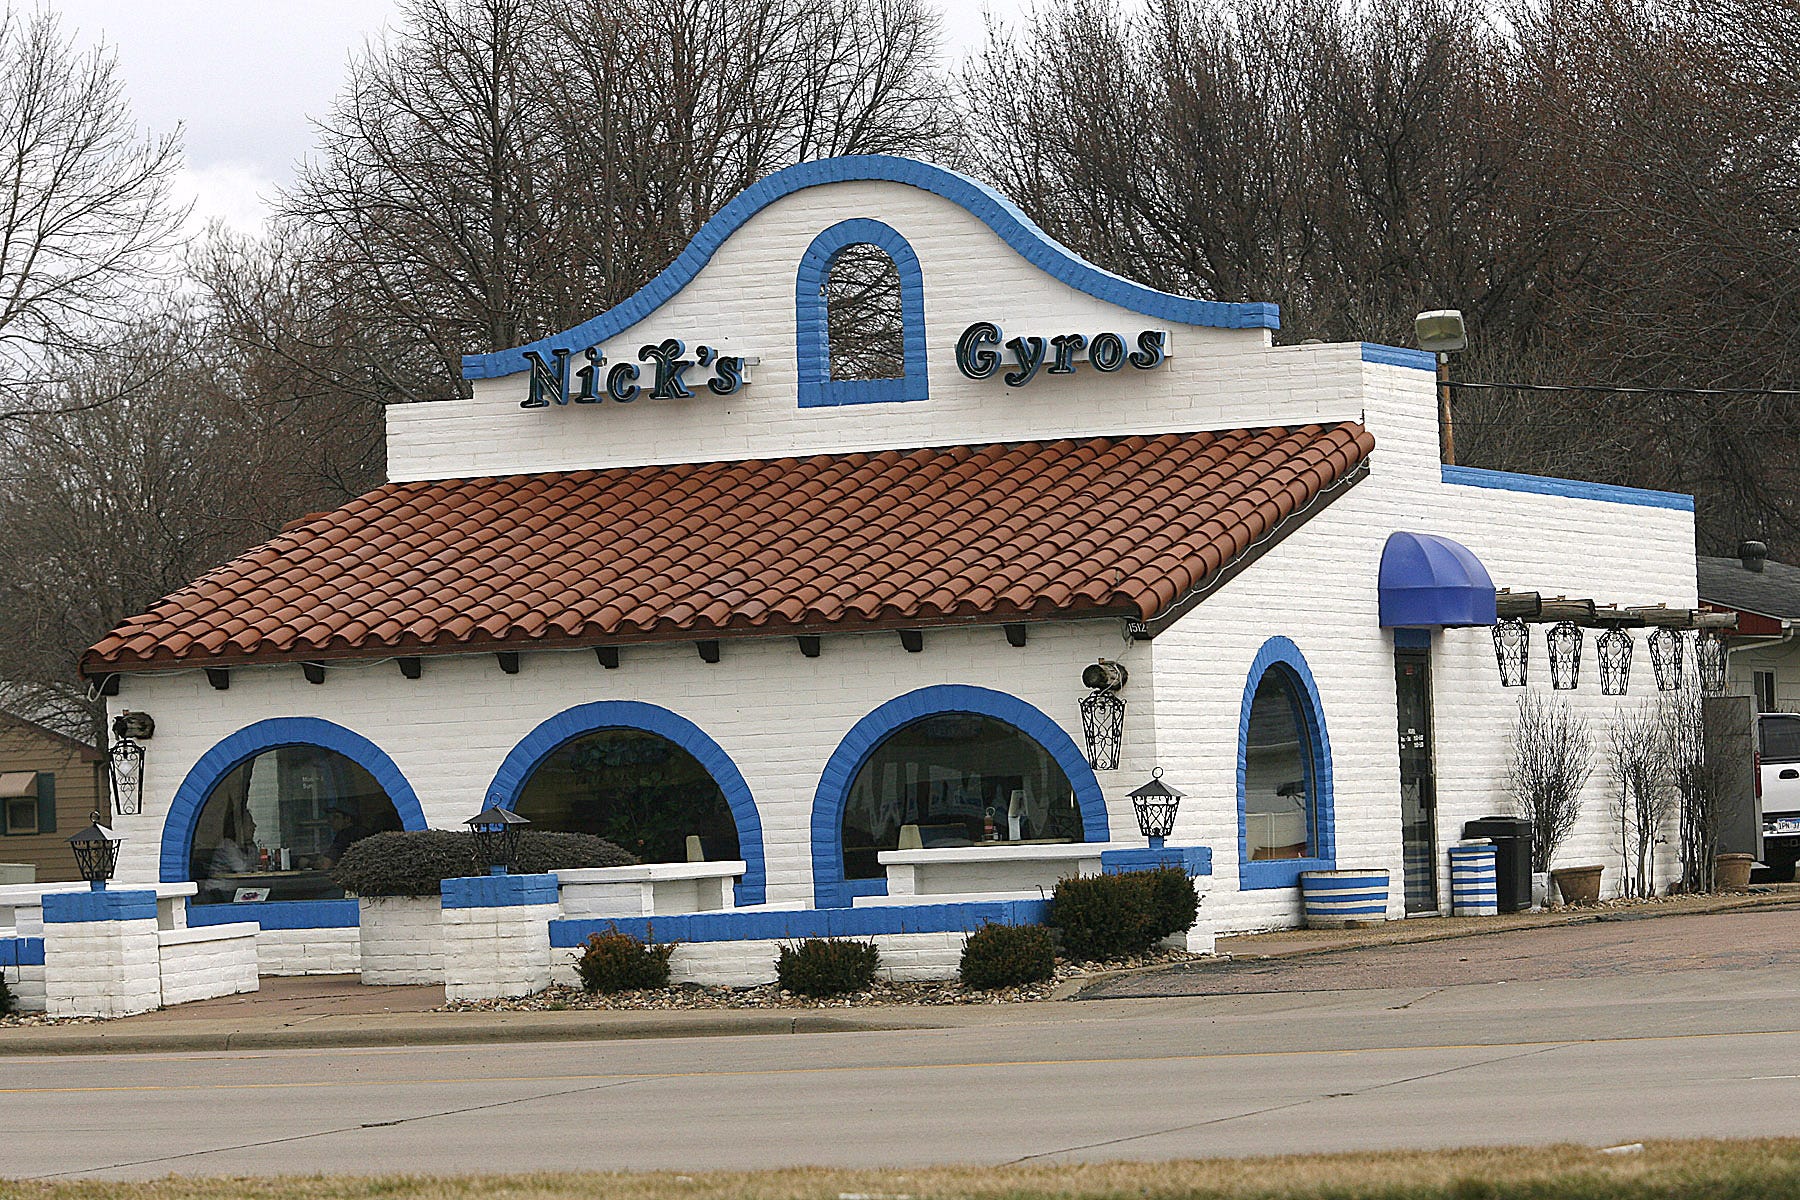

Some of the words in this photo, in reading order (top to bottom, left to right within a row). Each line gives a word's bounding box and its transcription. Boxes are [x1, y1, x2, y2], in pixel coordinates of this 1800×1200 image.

[520, 339, 744, 408] Nick's
[956, 321, 1167, 387] Gyros
[1128, 622, 1147, 632] 1512
